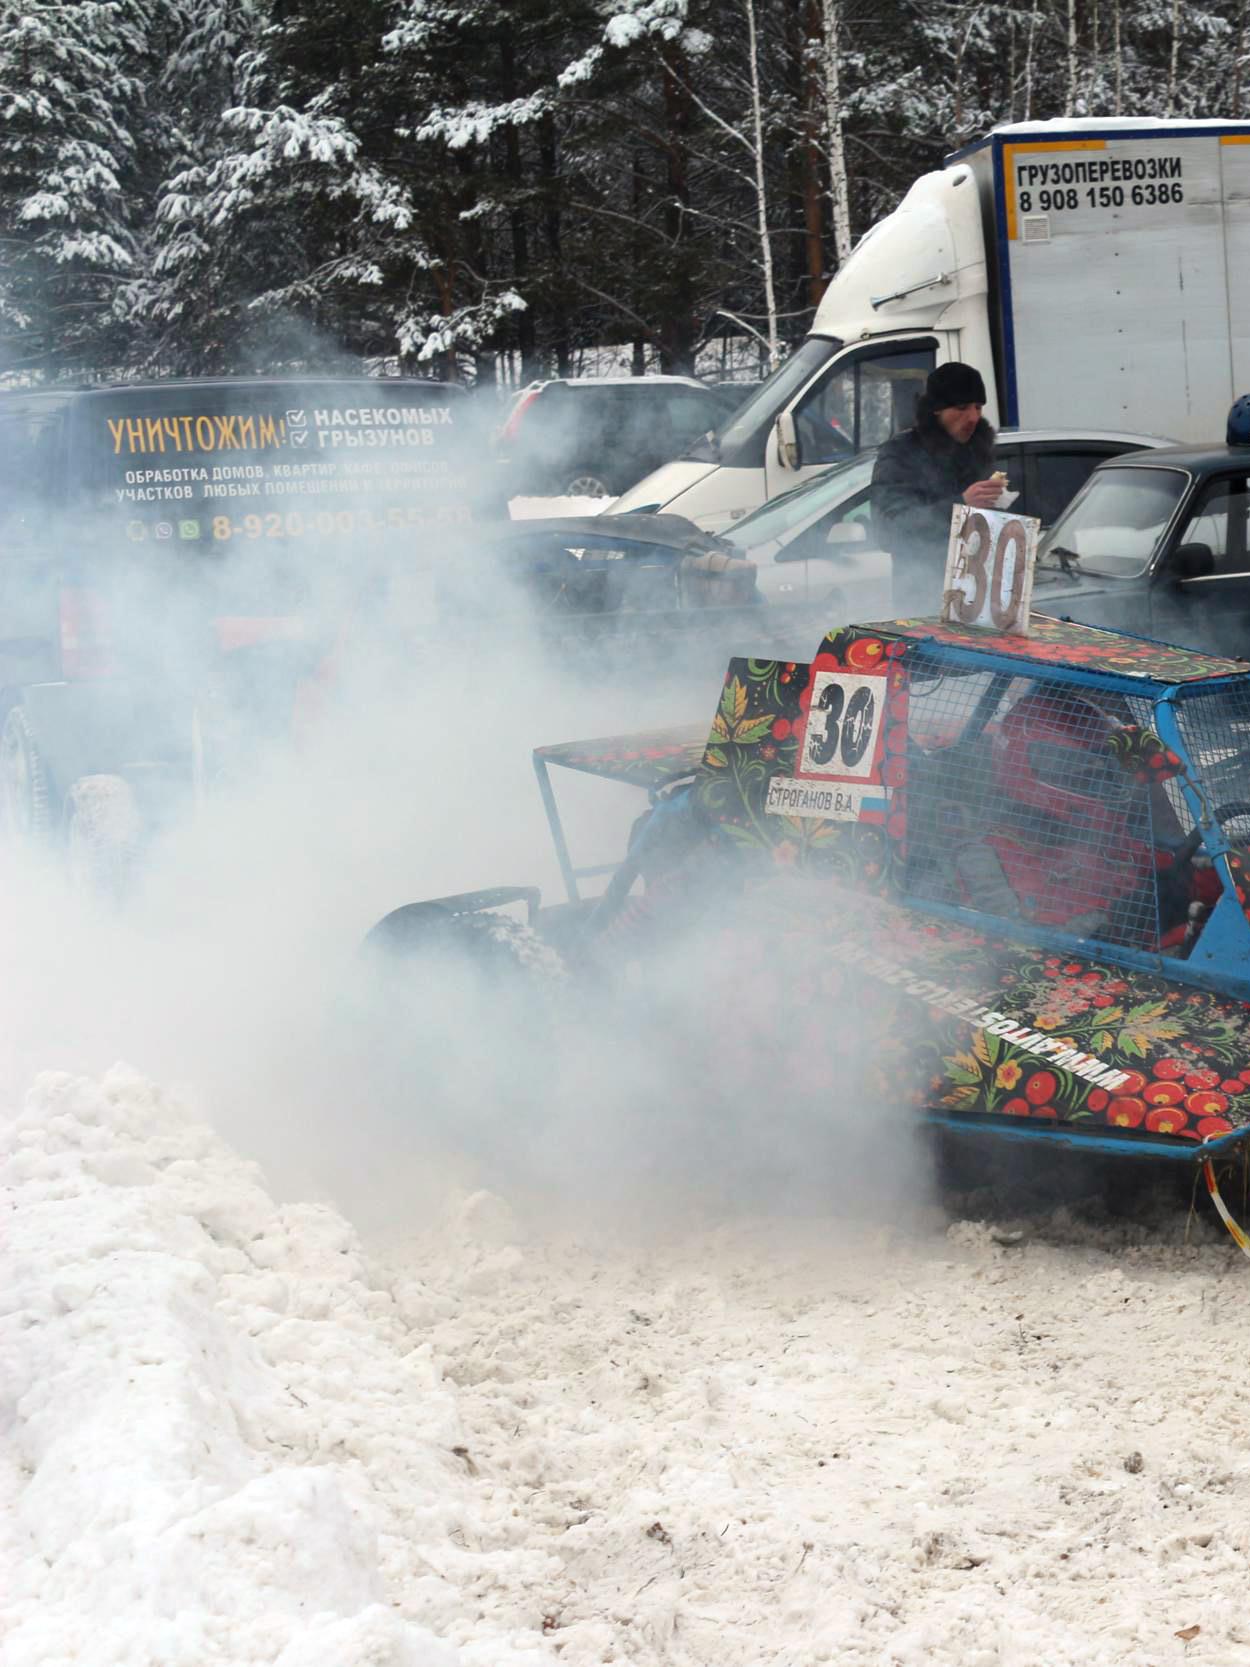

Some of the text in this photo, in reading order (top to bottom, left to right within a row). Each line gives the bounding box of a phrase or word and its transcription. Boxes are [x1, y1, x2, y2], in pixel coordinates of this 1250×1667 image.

[1017, 157, 1182, 187] ГРУЗОПЕРЕВОЗКИ
[1019, 182, 1184, 212] 8 908 150 6386
[314, 407, 452, 426] НАСЕКОМЫХ
[107, 411, 287, 455] УНИЧТОЖИМ!
[319, 428, 434, 448] ГРЫЗУНОВ
[125, 468, 209, 485] ОБРАБОТКА
[204, 483, 261, 498] ЛЮБЫХ
[943, 513, 1026, 630] 30
[808, 683, 875, 768] 30
[768, 786, 833, 811] СТРОГАНОВ
